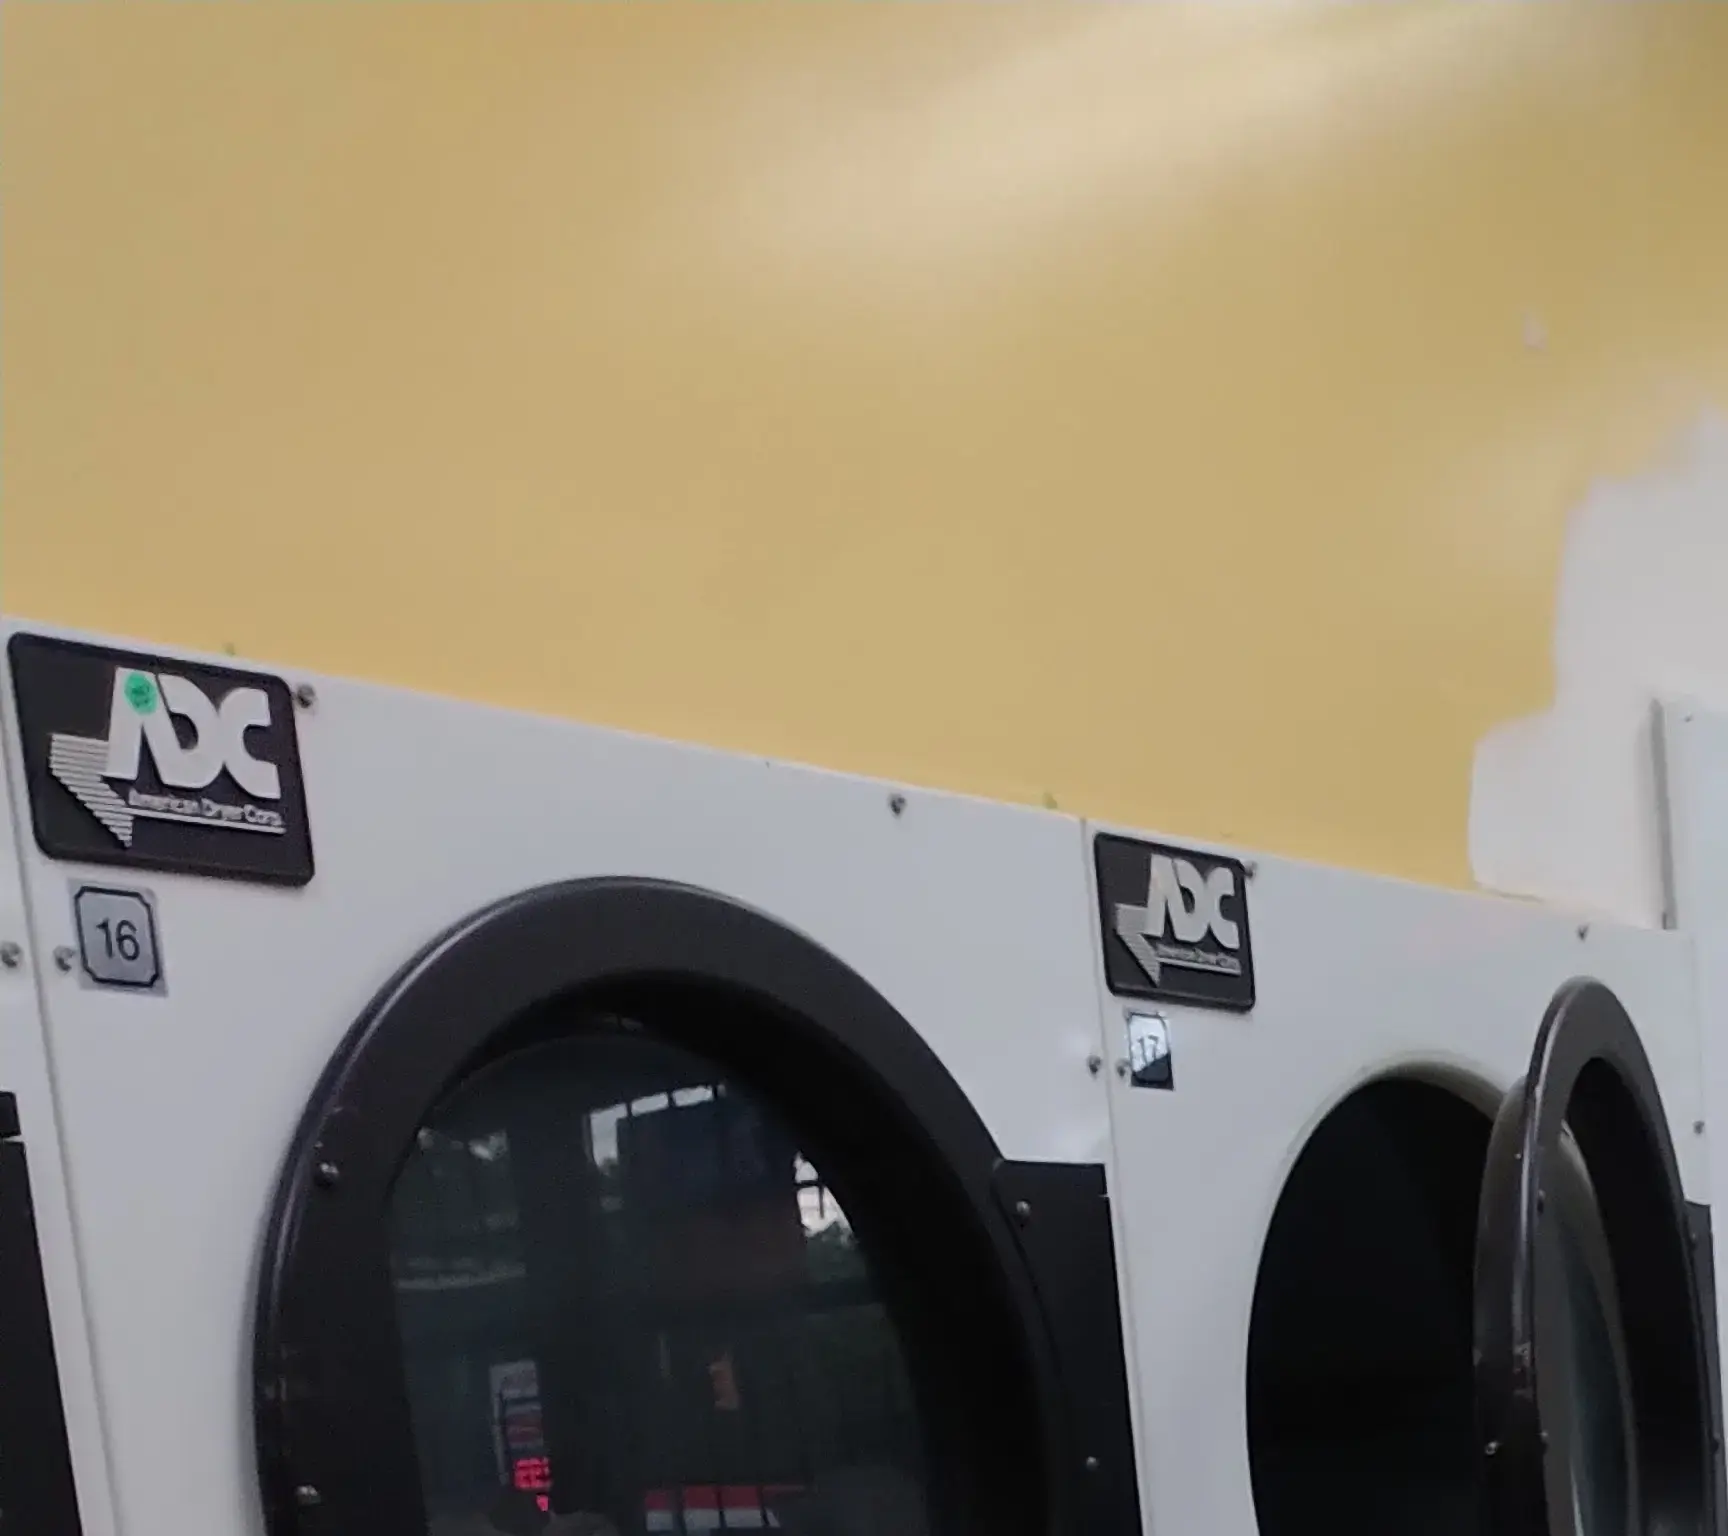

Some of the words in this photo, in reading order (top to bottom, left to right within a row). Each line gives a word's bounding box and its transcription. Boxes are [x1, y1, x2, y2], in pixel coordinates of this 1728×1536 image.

[103, 666, 282, 799] ADC
[96, 919, 140, 962] 16
[1144, 853, 1241, 950] ADC
